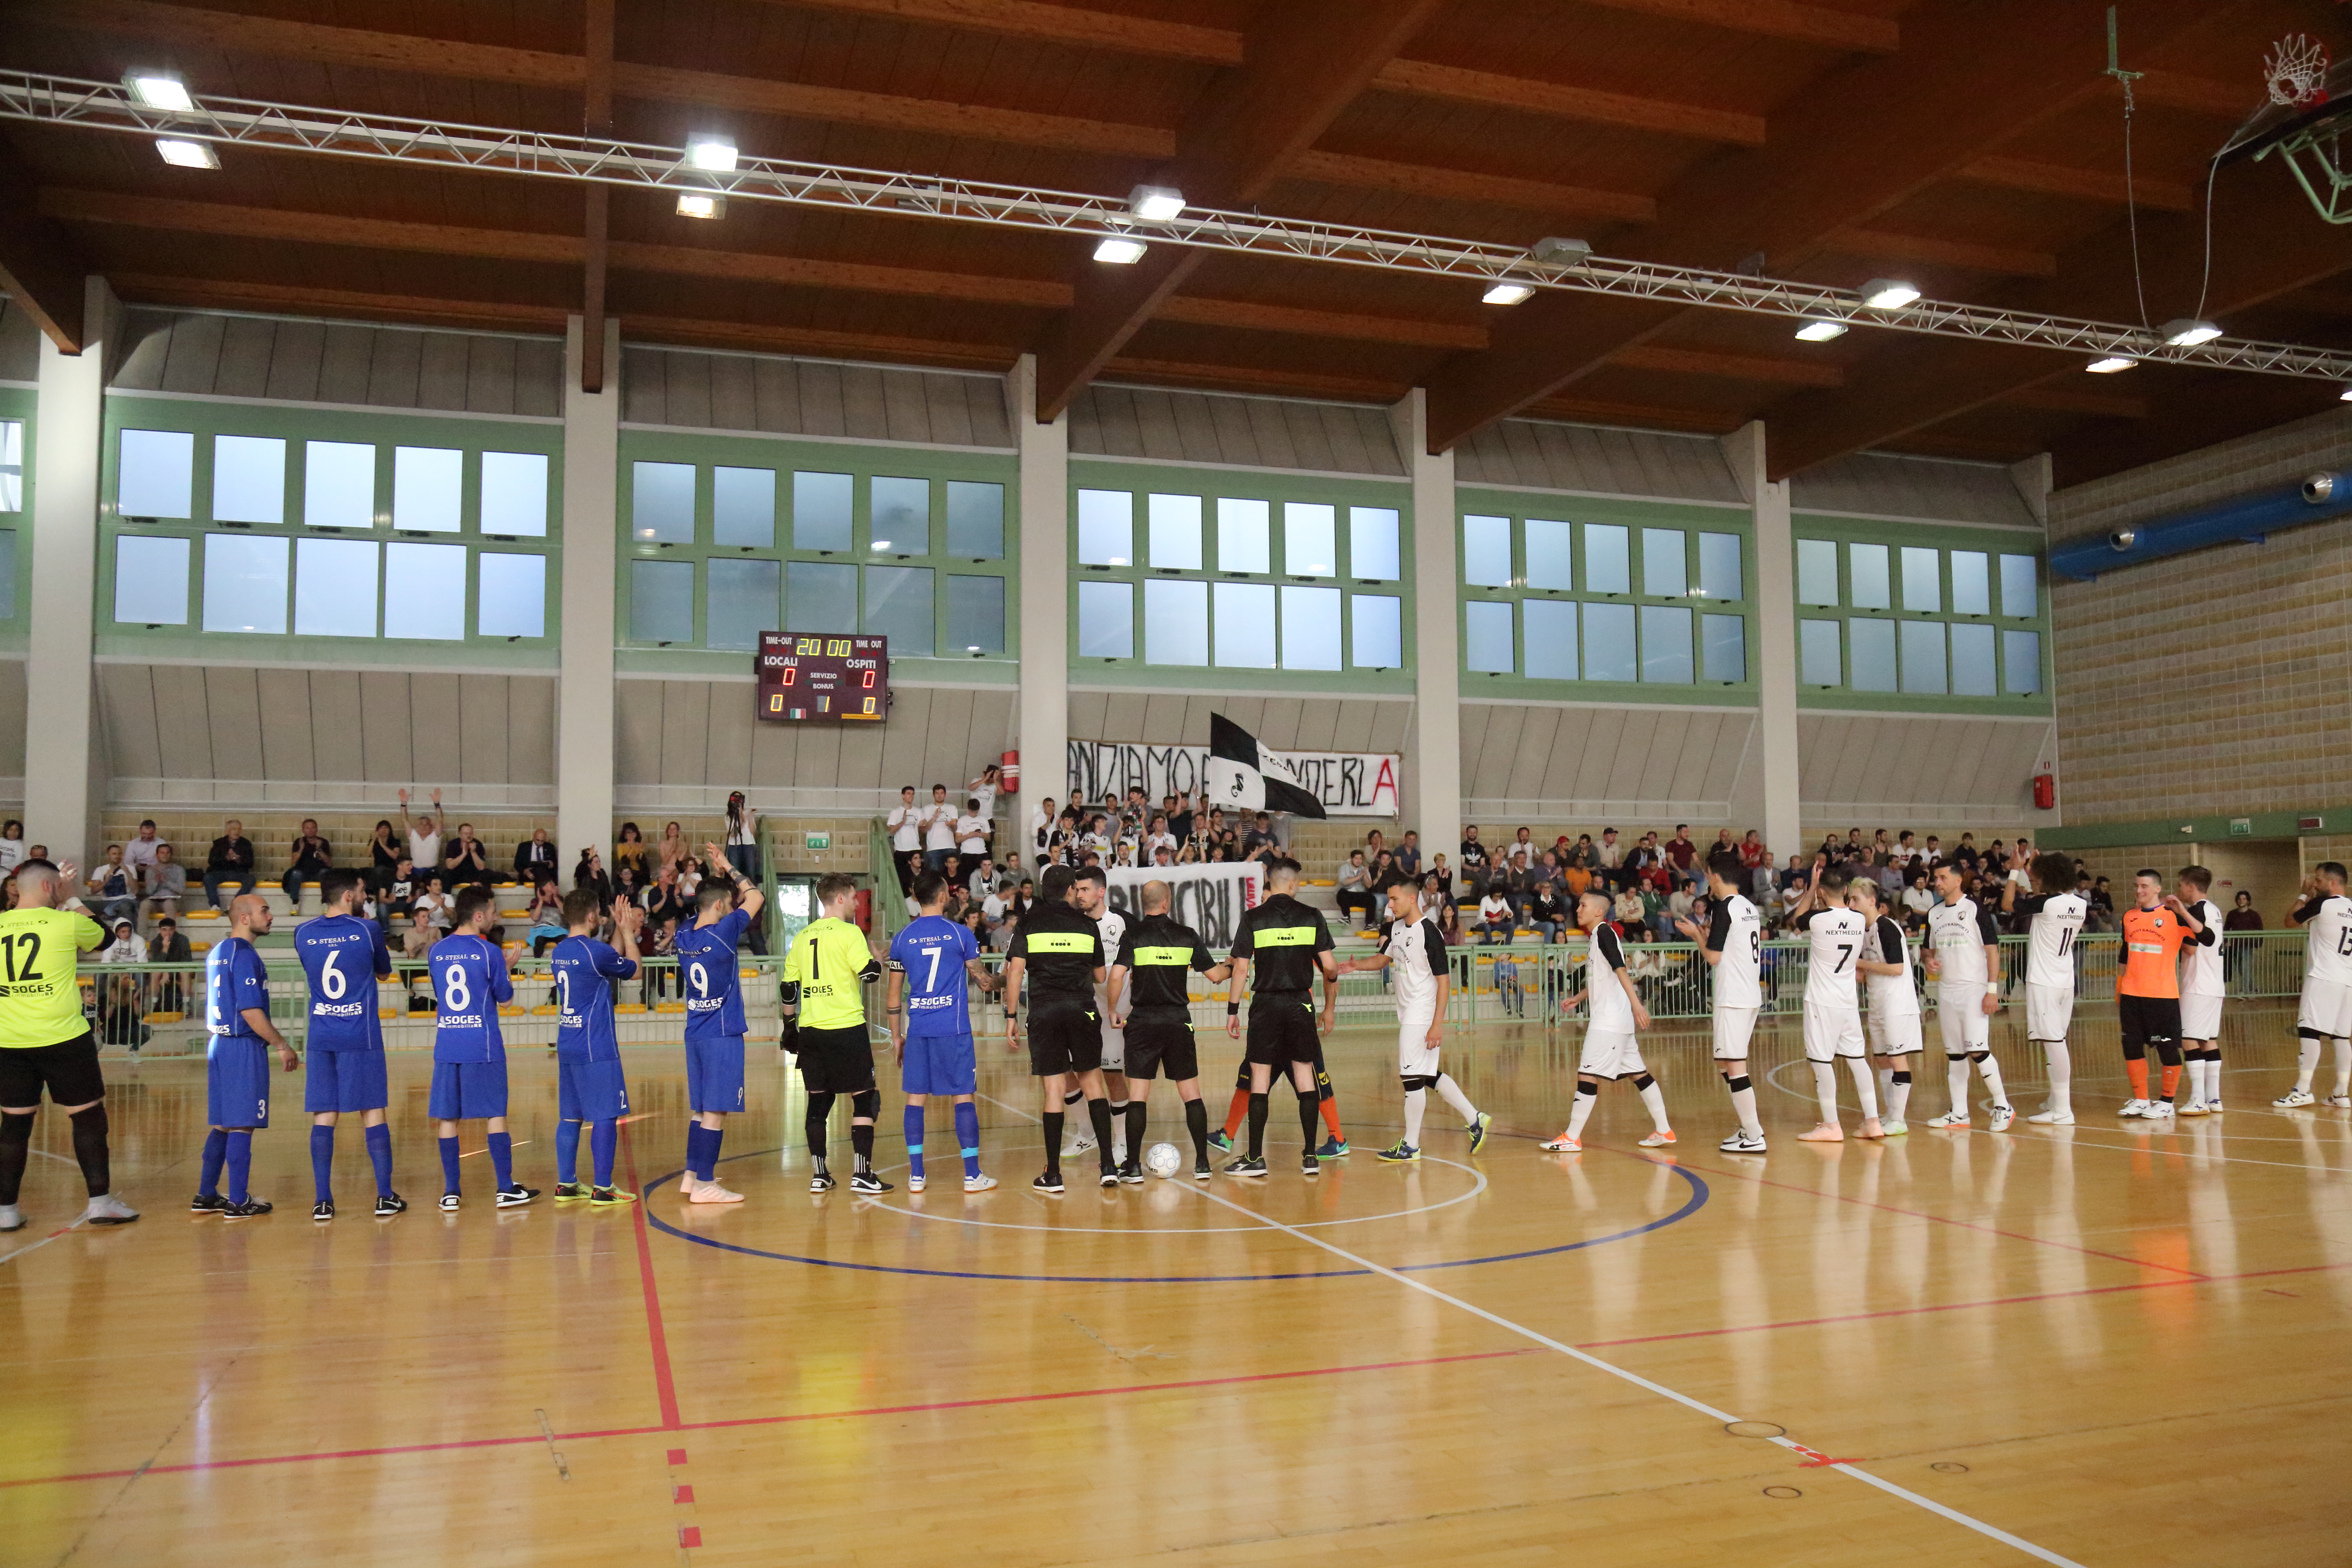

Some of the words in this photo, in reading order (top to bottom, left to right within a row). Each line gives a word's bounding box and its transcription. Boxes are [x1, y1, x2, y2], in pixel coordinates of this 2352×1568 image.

[796, 638, 821, 656] 20
[826, 639, 851, 657] 00
[871, 640, 882, 648] OUT
[764, 656, 798, 666] LOCALI
[846, 659, 876, 669] OSPITI
[782, 668, 796, 686] 0
[862, 670, 875, 688] 0
[771, 694, 783, 712] 0
[825, 696, 830, 713] 1
[863, 697, 876, 714] 0
[1067, 741, 1194, 803] ANDIAMO
[1750, 931, 1759, 964] 8
[2058, 927, 2073, 956] 11
[1, 933, 43, 982] 12
[809, 938, 819, 980] 1
[1834, 944, 1853, 973] 7
[322, 950, 346, 999] 6
[922, 947, 942, 993] 7
[12, 984, 53, 993] SOGES
[445, 964, 470, 1011] 8
[690, 962, 708, 998] 9
[557, 970, 575, 1014] 2
[920, 995, 952, 1005] SOGES
[325, 1002, 362, 1013] SOGES
[696, 997, 723, 1008] SOGES
[445, 1015, 482, 1025] SOGES
[619, 1090, 627, 1109] 2
[737, 1087, 743, 1105] 9
[257, 1099, 266, 1119] 3
